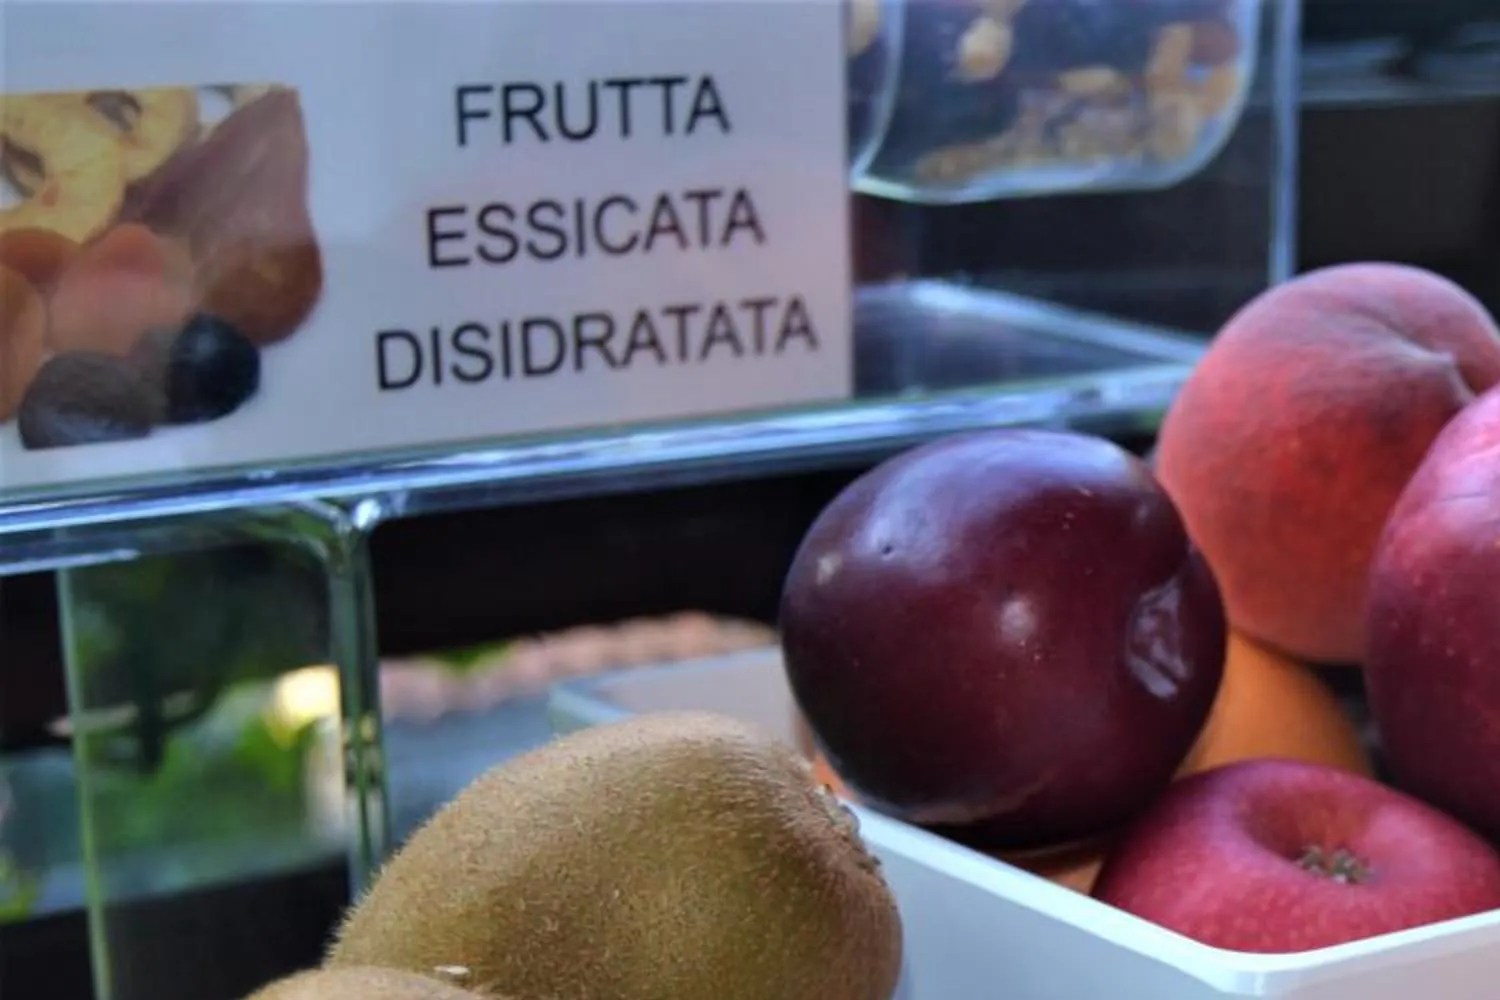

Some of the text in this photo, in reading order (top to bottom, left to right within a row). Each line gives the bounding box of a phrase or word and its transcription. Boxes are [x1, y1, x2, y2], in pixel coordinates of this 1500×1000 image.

[455, 75, 731, 147] FRUTTA
[425, 188, 765, 270] ESSICATA
[375, 297, 818, 392] DISIDRATATA
